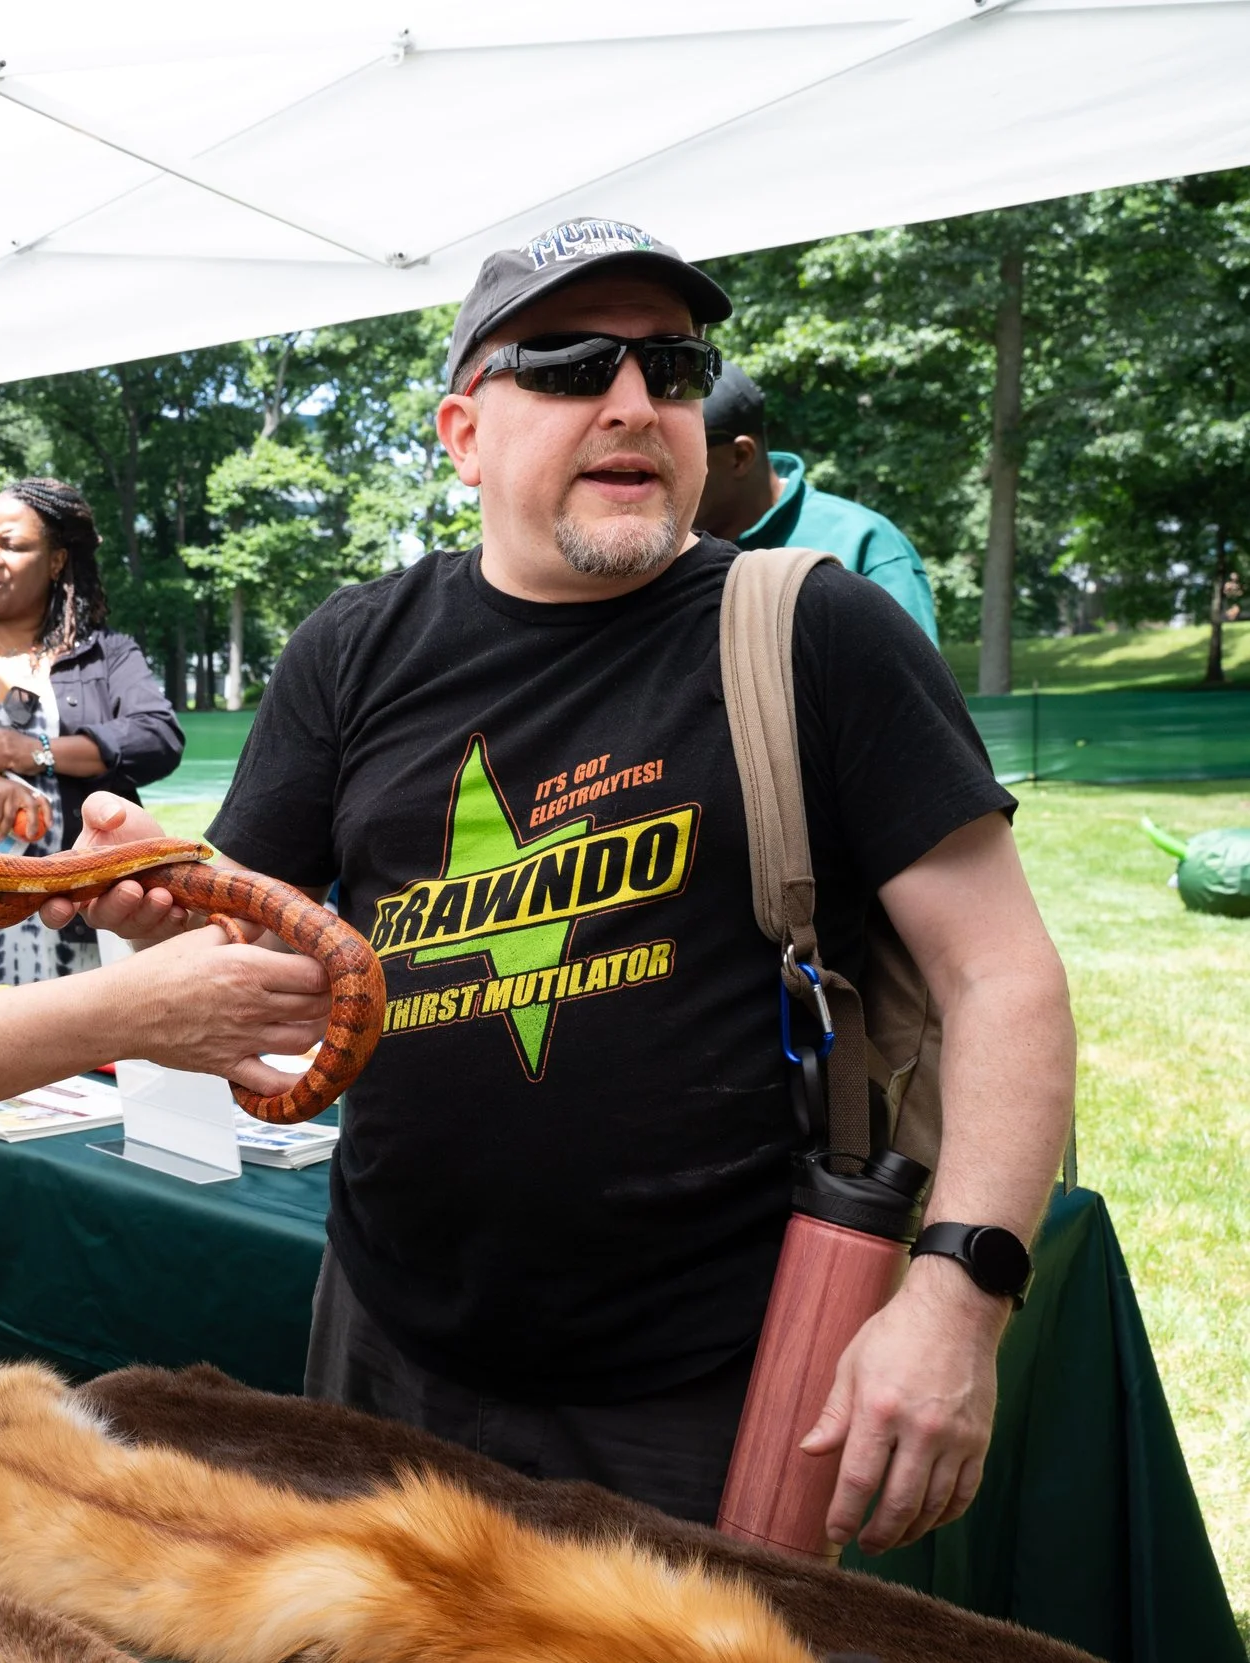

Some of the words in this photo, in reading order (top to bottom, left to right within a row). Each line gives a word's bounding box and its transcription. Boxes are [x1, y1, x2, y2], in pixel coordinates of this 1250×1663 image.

[529, 759, 664, 829] ELECTROLYTES!
[534, 772, 567, 802] IT'S
[573, 753, 611, 782] GOT
[372, 822, 680, 949] BRAWNDO
[383, 984, 480, 1032] THIRST
[481, 943, 672, 1014] MUTILATOR
